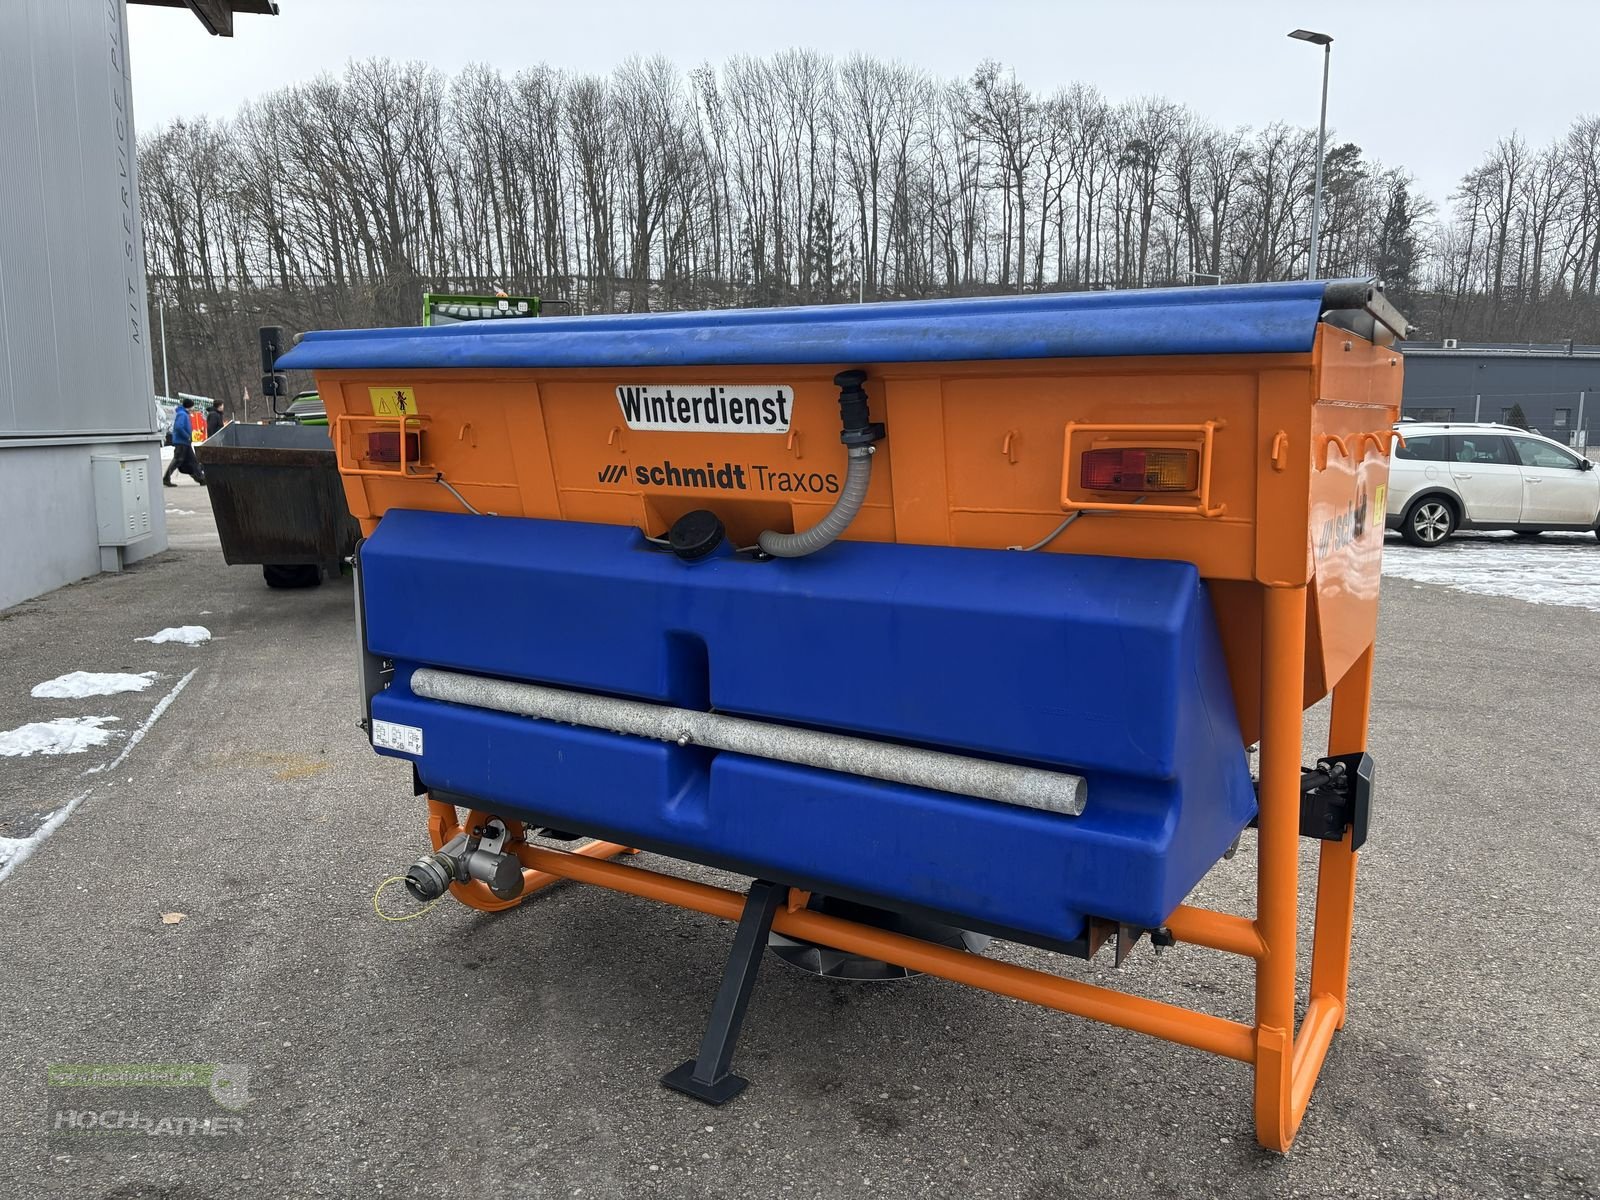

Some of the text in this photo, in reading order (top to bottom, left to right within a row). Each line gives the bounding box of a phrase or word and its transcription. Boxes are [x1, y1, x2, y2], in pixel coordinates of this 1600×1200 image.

[112, 88, 134, 262] SERVICE
[128, 278, 141, 344] MIT
[618, 386, 789, 425] Winterdienst
[636, 461, 840, 494] schmidt Traxos
